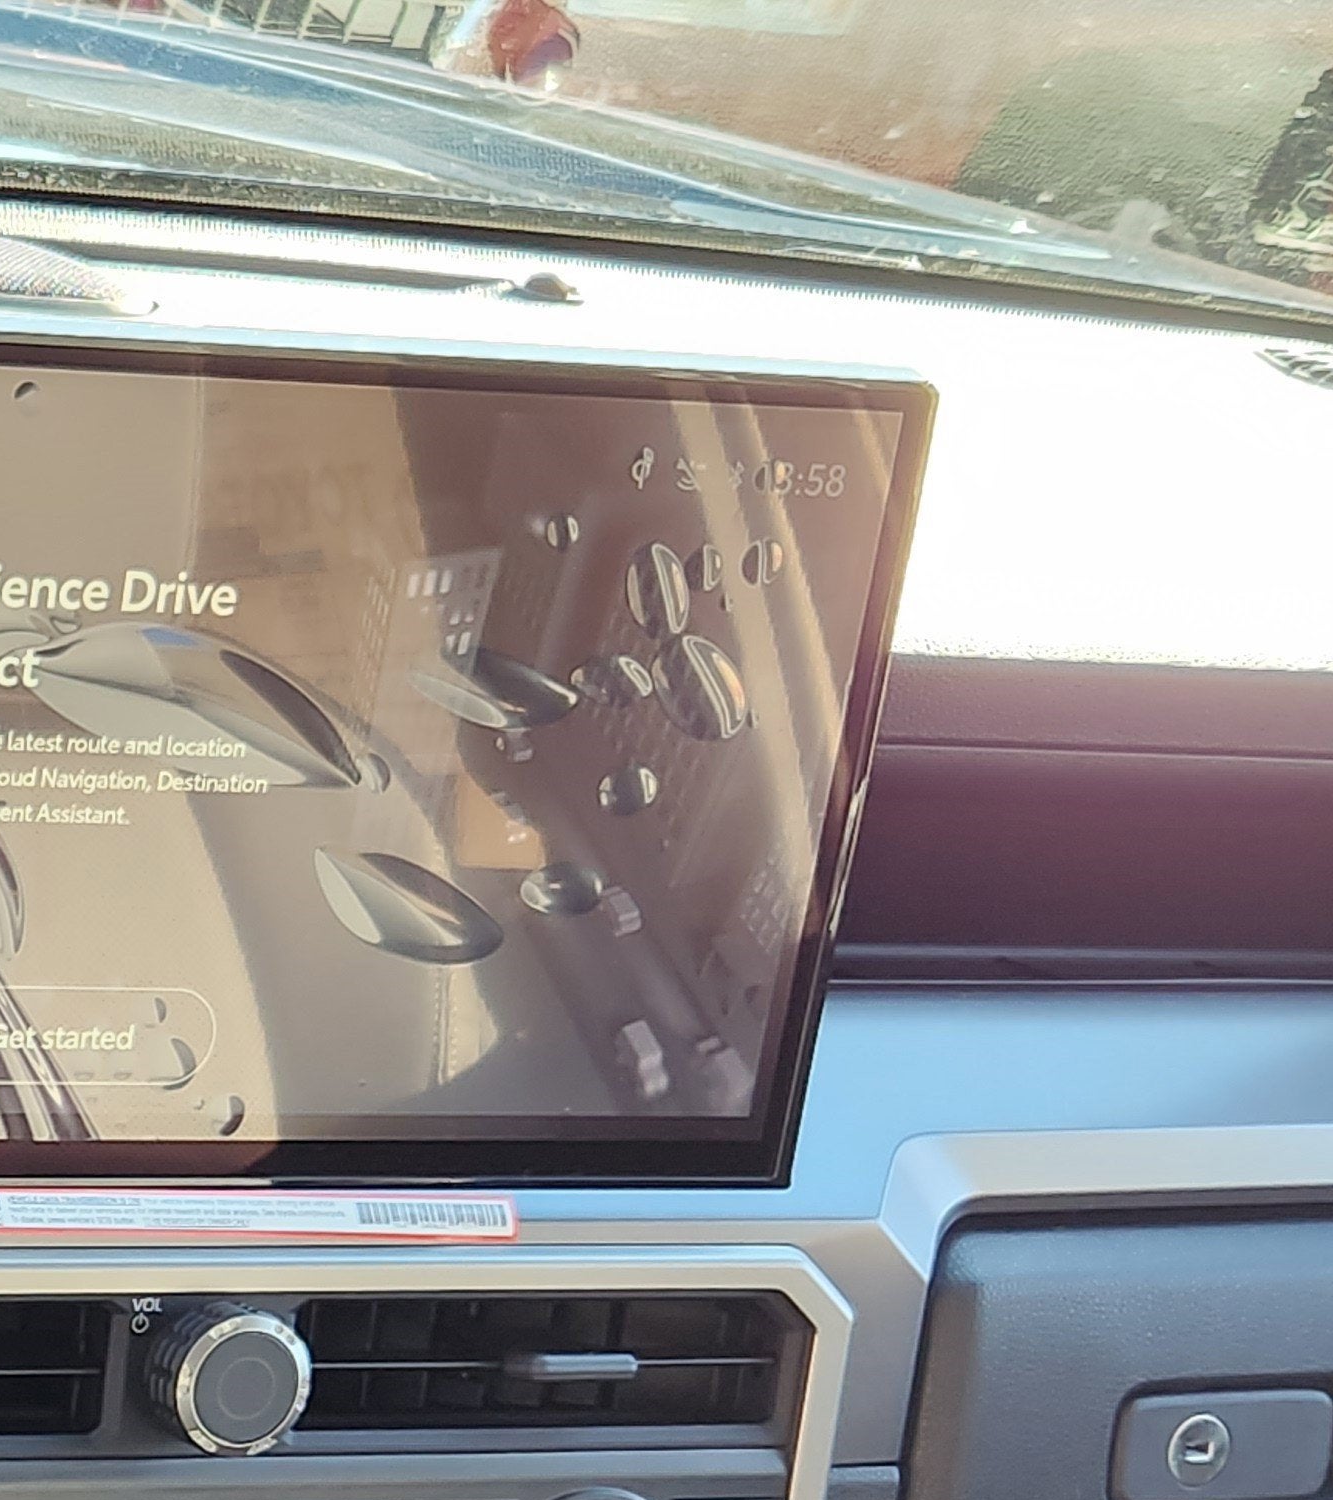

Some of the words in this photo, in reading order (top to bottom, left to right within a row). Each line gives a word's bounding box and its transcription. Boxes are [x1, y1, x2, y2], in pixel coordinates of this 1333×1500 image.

[121, 569, 238, 616] Drive
[7, 731, 63, 753] latest
[67, 733, 120, 755] route
[123, 733, 164, 756] and
[166, 736, 247, 759] location
[40, 768, 152, 794] Navigation,
[156, 771, 269, 794] Destination
[35, 802, 130, 826] Assistant.
[41, 1024, 136, 1052] started
[132, 1298, 163, 1313] VOL
